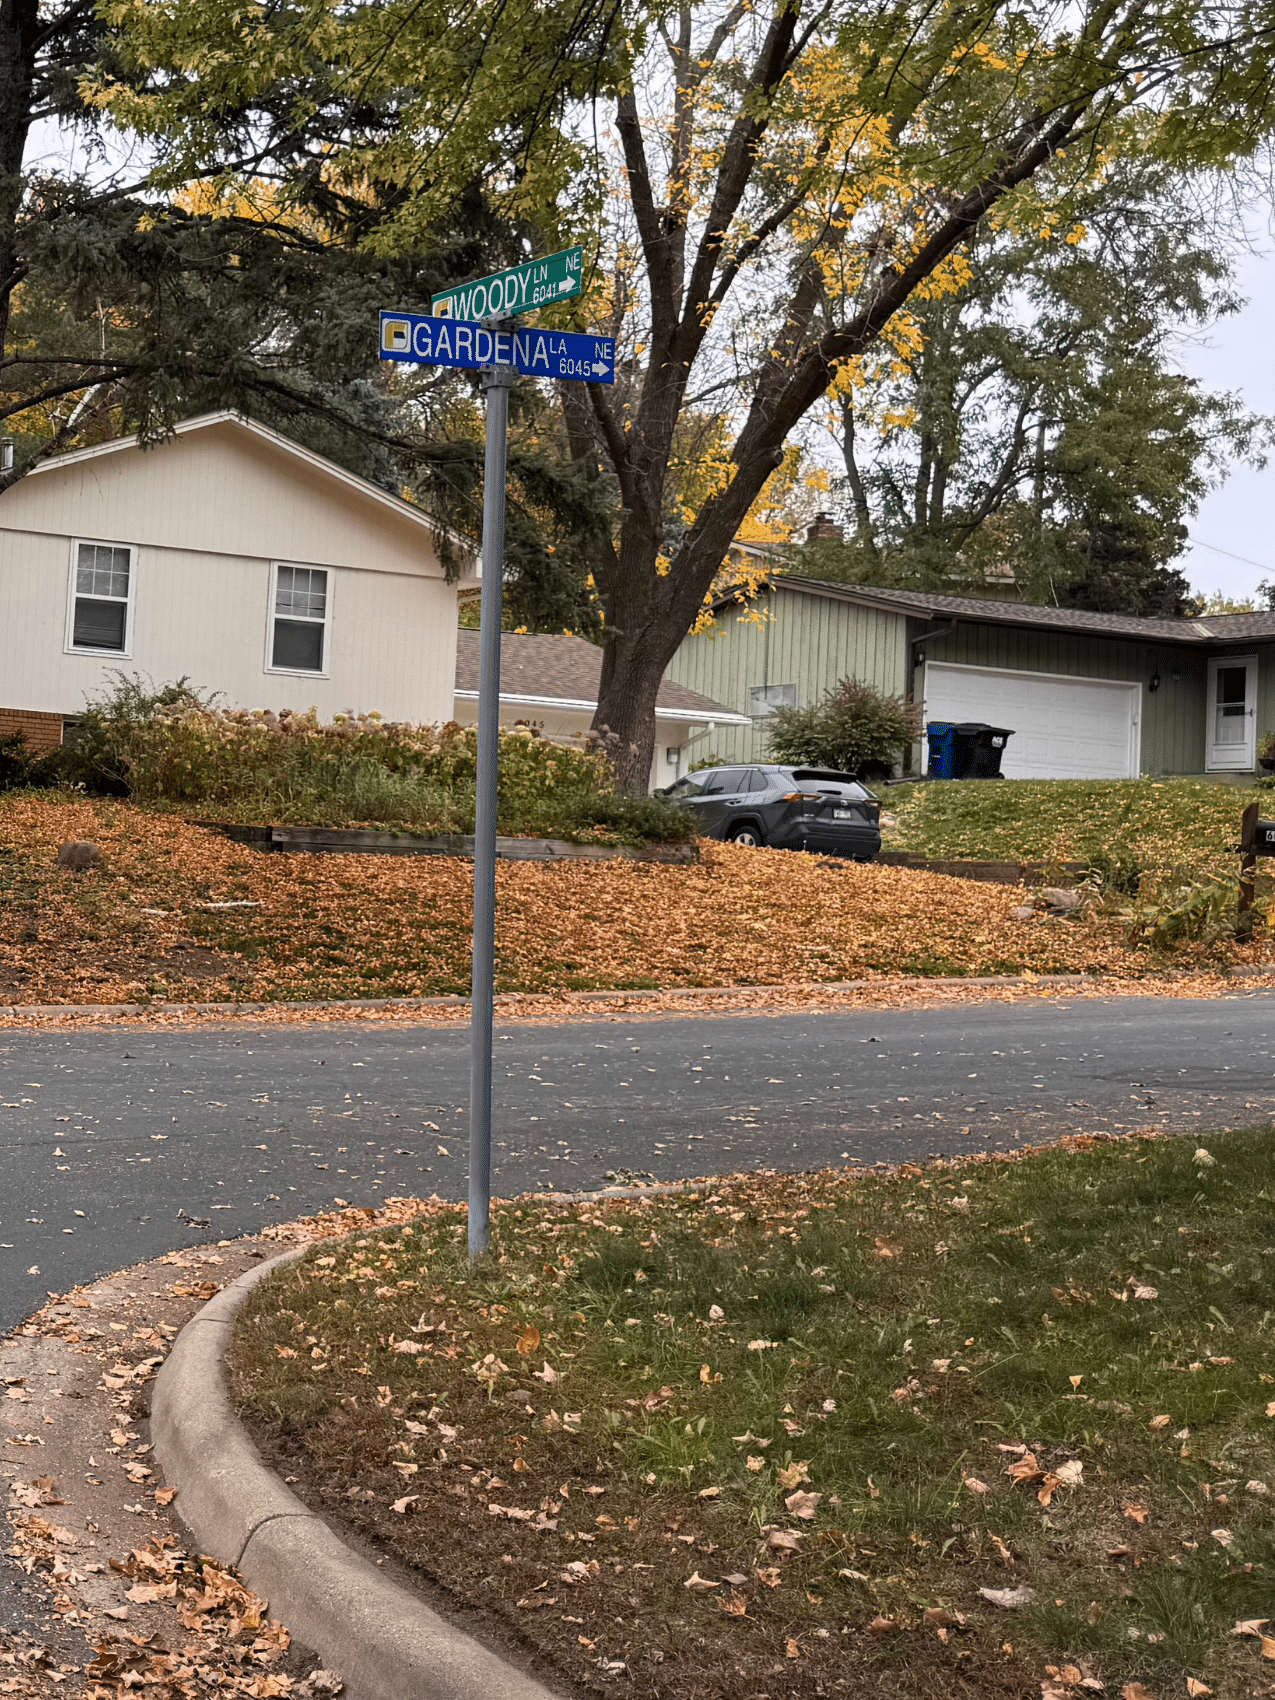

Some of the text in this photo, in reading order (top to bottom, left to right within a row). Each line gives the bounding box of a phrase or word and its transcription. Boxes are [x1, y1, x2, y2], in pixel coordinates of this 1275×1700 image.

[454, 251, 580, 321] WOODY LN NE
[533, 282, 556, 304] 6041
[413, 322, 612, 368] GARDENA LA NE
[560, 357, 591, 376] 6045
